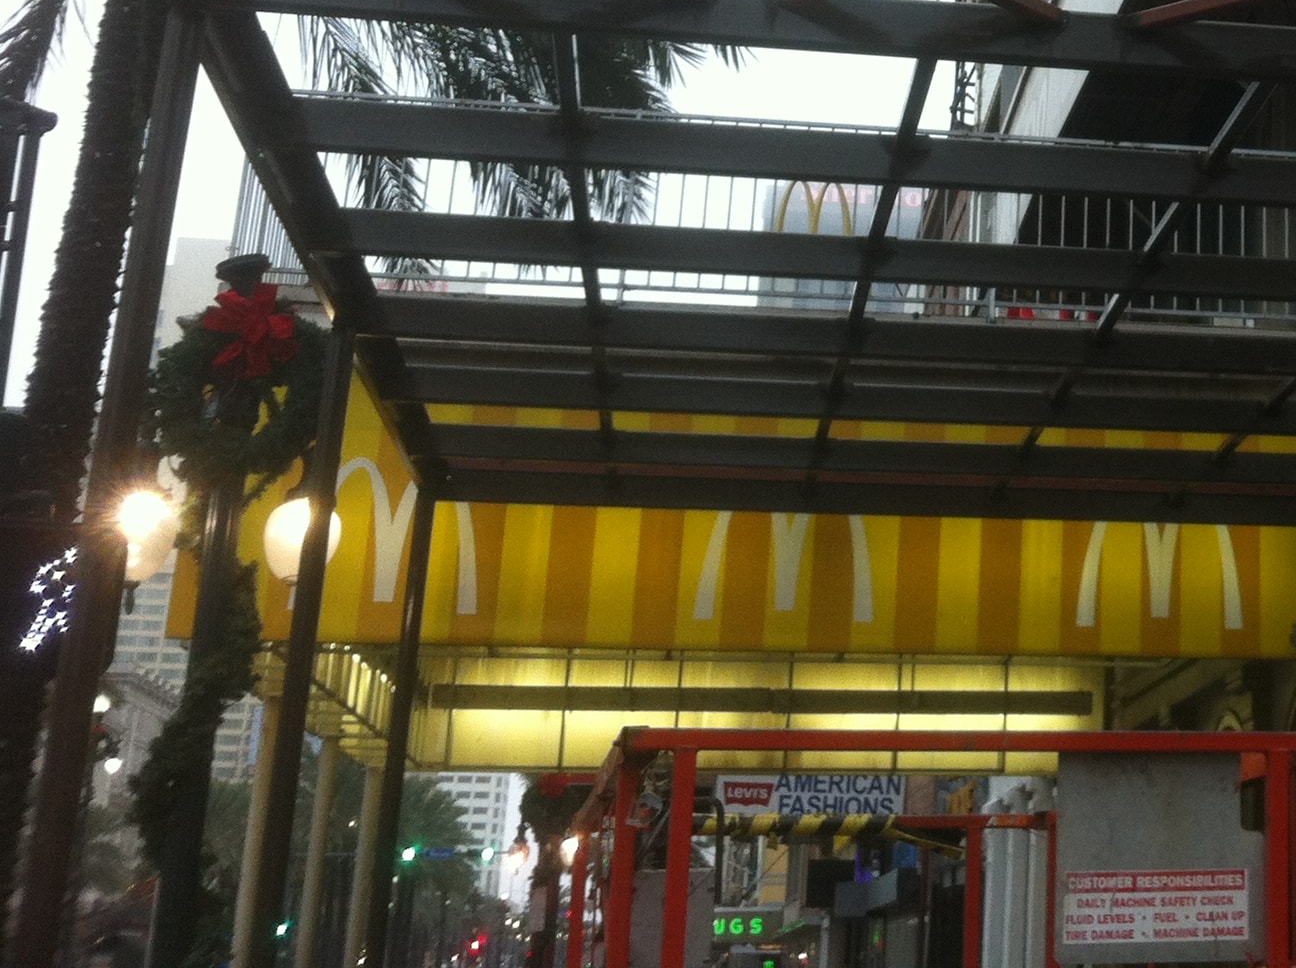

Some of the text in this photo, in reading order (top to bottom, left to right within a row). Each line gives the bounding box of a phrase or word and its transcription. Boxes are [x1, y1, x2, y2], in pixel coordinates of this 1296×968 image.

[774, 774, 901, 795] AMERICAN
[778, 795, 894, 814] FASHIONS
[1068, 873, 1243, 889] CUSTOMER RESPONSIBILITIES
[1077, 895, 1234, 908] DAILY MACHINE SAFETY CHECK
[1065, 910, 1246, 925] FLUID LEVELS FUEL CLEAN UP
[1065, 926, 1245, 941] TIRE DAMAGE MACHINE DAMAGE
